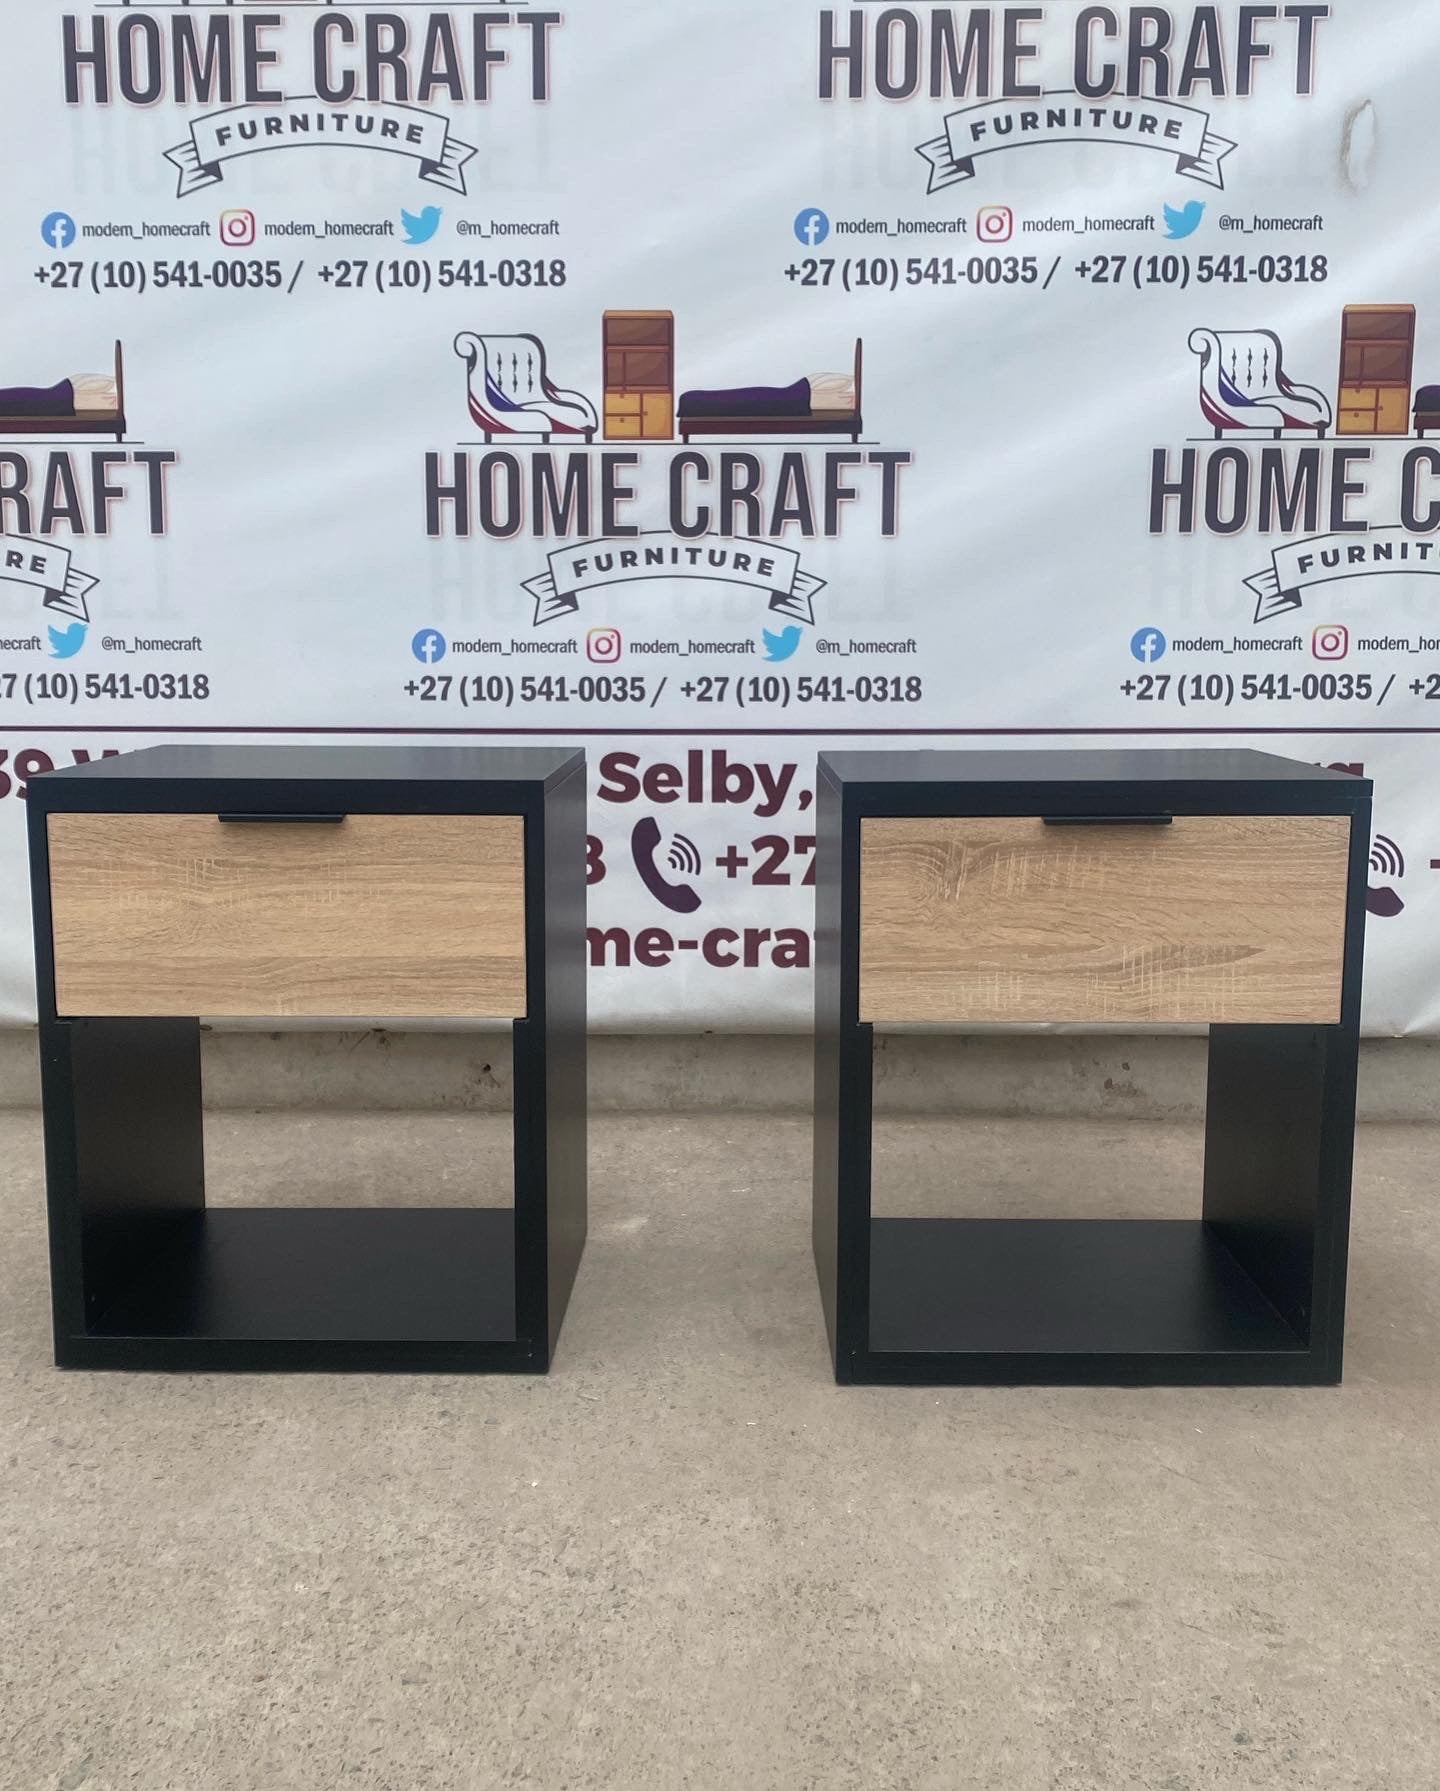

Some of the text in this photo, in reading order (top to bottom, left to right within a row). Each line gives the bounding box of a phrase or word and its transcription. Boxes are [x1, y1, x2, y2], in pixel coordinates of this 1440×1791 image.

[61, 11, 561, 104] HOME CRAFT
[817, 4, 1329, 99] HOME CRAFT
[216, 112, 425, 147] FURNITURE
[969, 107, 1184, 142] FURNITURE
[456, 219, 560, 239] @m_homecraft
[1218, 214, 1323, 234] @m_homecraft
[34, 261, 84, 288] +27
[91, 260, 146, 295] (10)
[153, 260, 282, 288] 541-0035
[317, 259, 369, 288] +27
[375, 259, 431, 294] (10)
[438, 259, 567, 287] 541-0318
[784, 258, 836, 286] +27
[842, 257, 899, 292] (10)
[905, 256, 1038, 285] 541-0035
[1074, 255, 1127, 283] +27
[1133, 255, 1190, 290] (10)
[1196, 254, 1328, 283] 541-0318
[424, 451, 911, 537] HOME CRAFT
[1149, 446, 1371, 534] HOME
[572, 546, 776, 579] FURNITURE
[1297, 541, 1440, 574] FURNIT
[101, 636, 203, 654] @m_homecraft
[815, 638, 917, 657] @m_homecraft
[24, 672, 78, 705] (10)
[84, 673, 210, 700] 541-0318
[403, 675, 453, 701] +27
[459, 675, 514, 708] (10)
[520, 675, 646, 703] 541-0035
[680, 676, 730, 702] +27
[736, 676, 791, 708] (10)
[796, 675, 922, 703] 541-0318
[1120, 674, 1171, 701] +27
[1177, 674, 1234, 707] (10)
[1240, 673, 1373, 701] 541-0035
[597, 749, 813, 817] Selby,
[586, 927, 815, 968] me-cra
